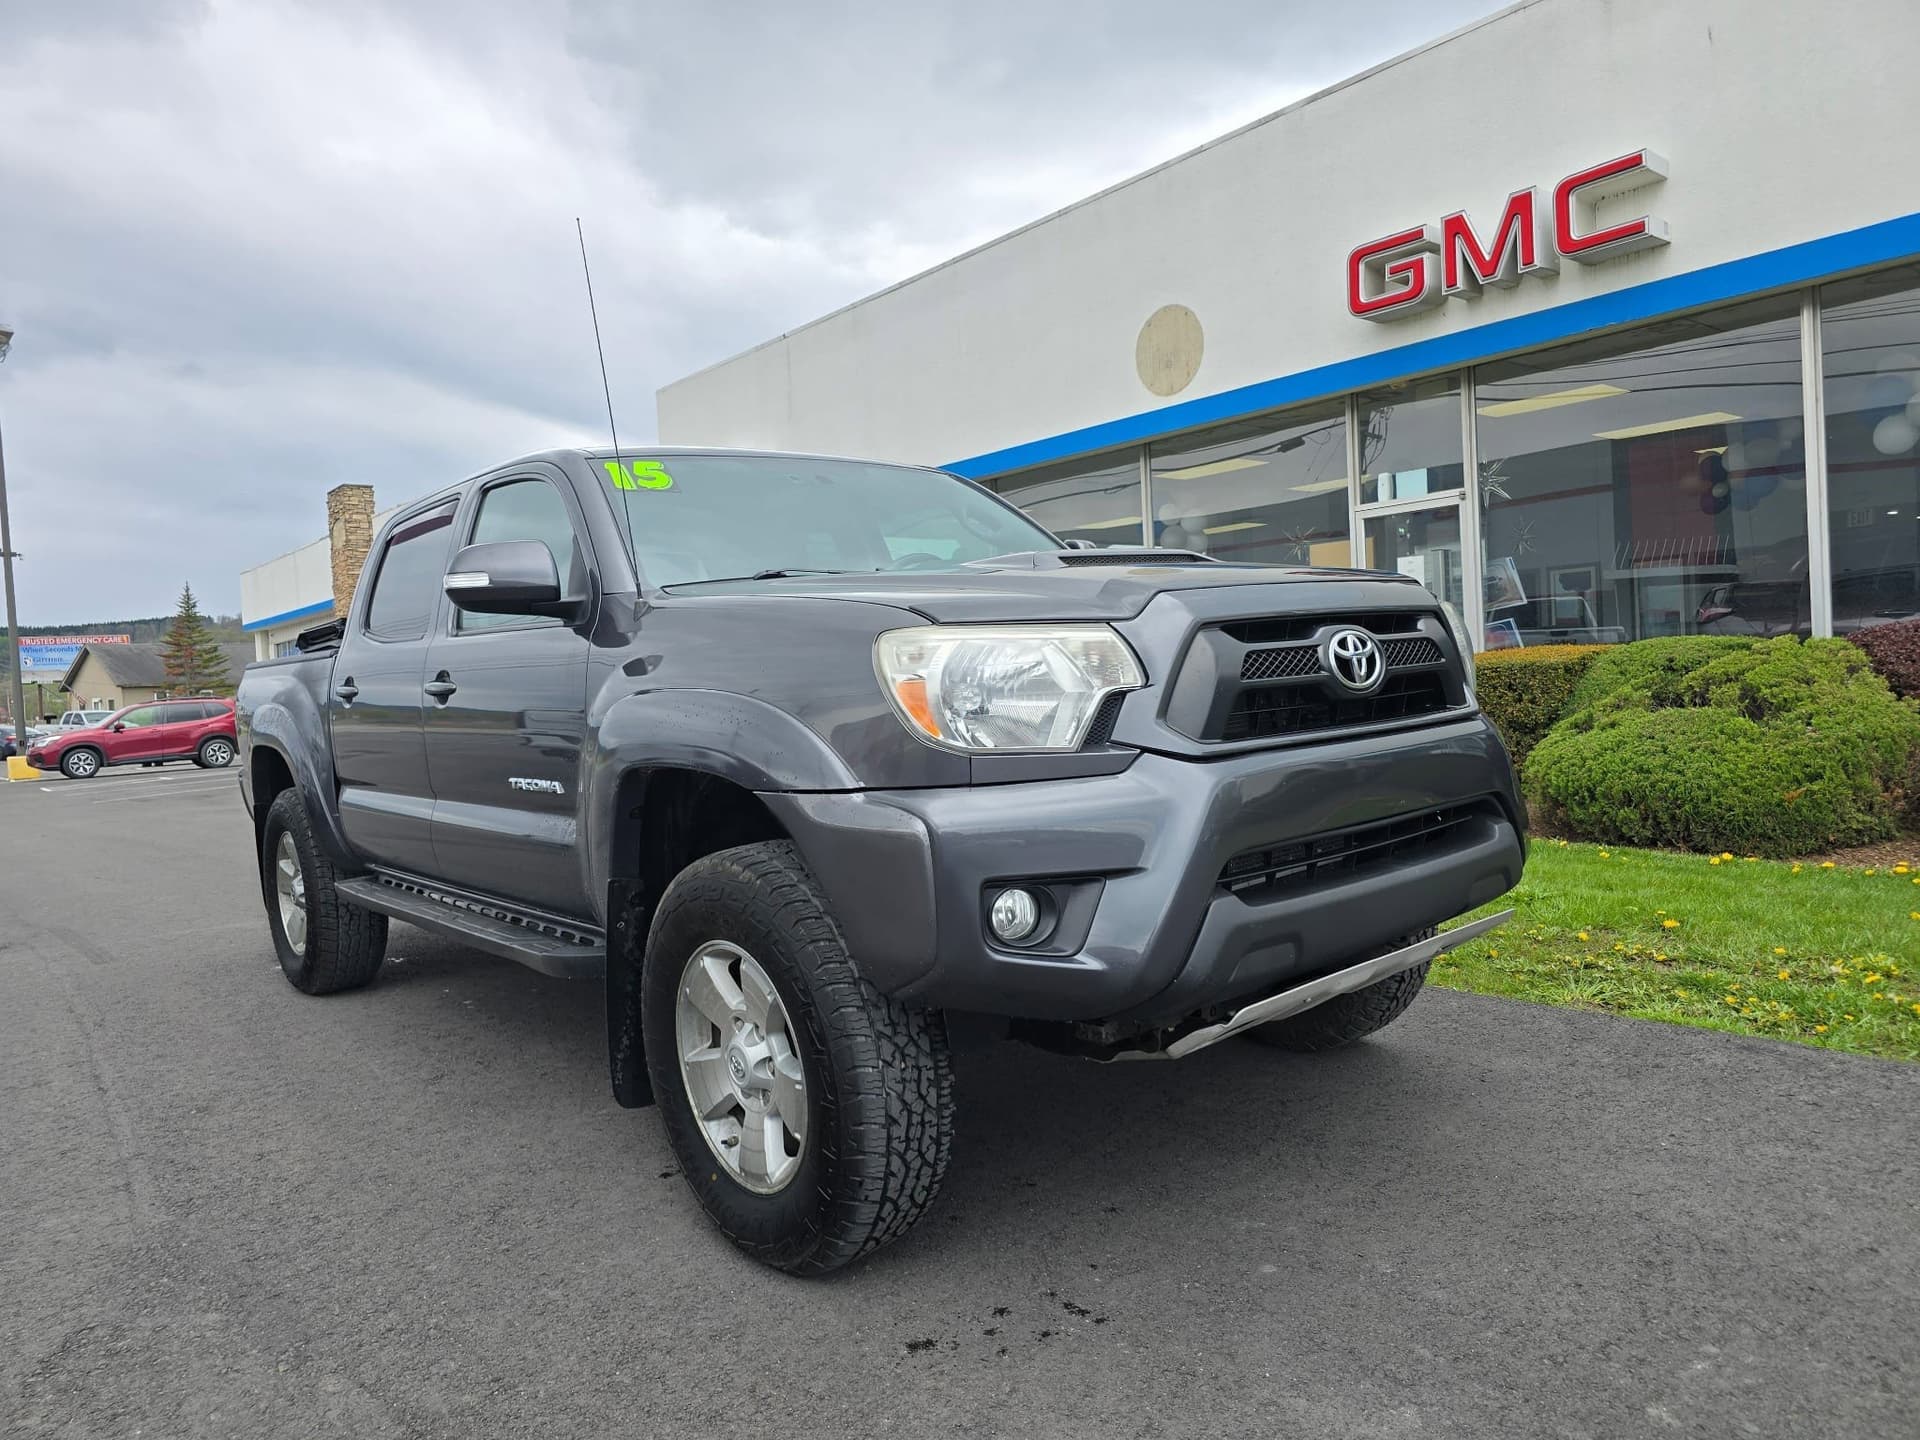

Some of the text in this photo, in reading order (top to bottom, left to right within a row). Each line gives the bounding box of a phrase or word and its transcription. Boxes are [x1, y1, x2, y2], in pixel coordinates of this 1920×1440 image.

[1347, 148, 1655, 317] GMC
[604, 461, 672, 490] 15
[57, 637, 101, 645] EMERGENCY
[508, 778, 566, 794] TACOMA
